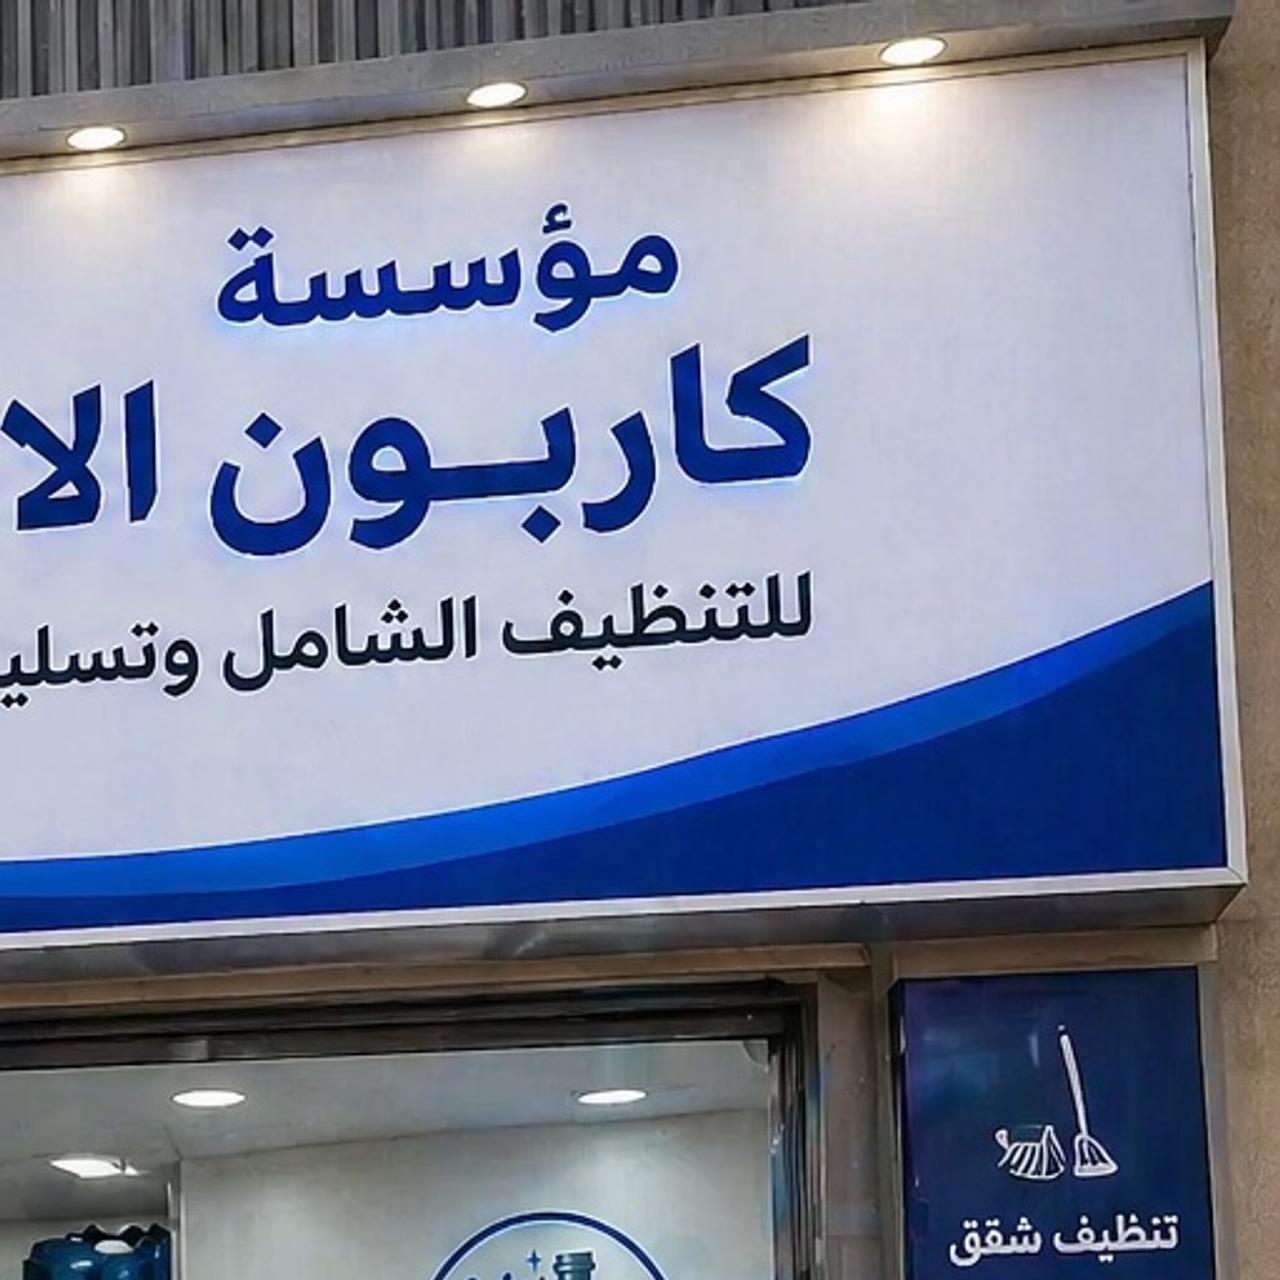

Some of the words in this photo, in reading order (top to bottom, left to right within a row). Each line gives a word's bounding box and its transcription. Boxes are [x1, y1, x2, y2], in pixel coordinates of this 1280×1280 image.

[217, 203, 679, 333] مؤسسة
[210, 335, 811, 557] كاربون
[223, 595, 477, 692] الشامل
[502, 571, 812, 671] للتنظيف
[949, 1217, 1042, 1267] شقق
[1053, 1214, 1178, 1262] تنظيف
